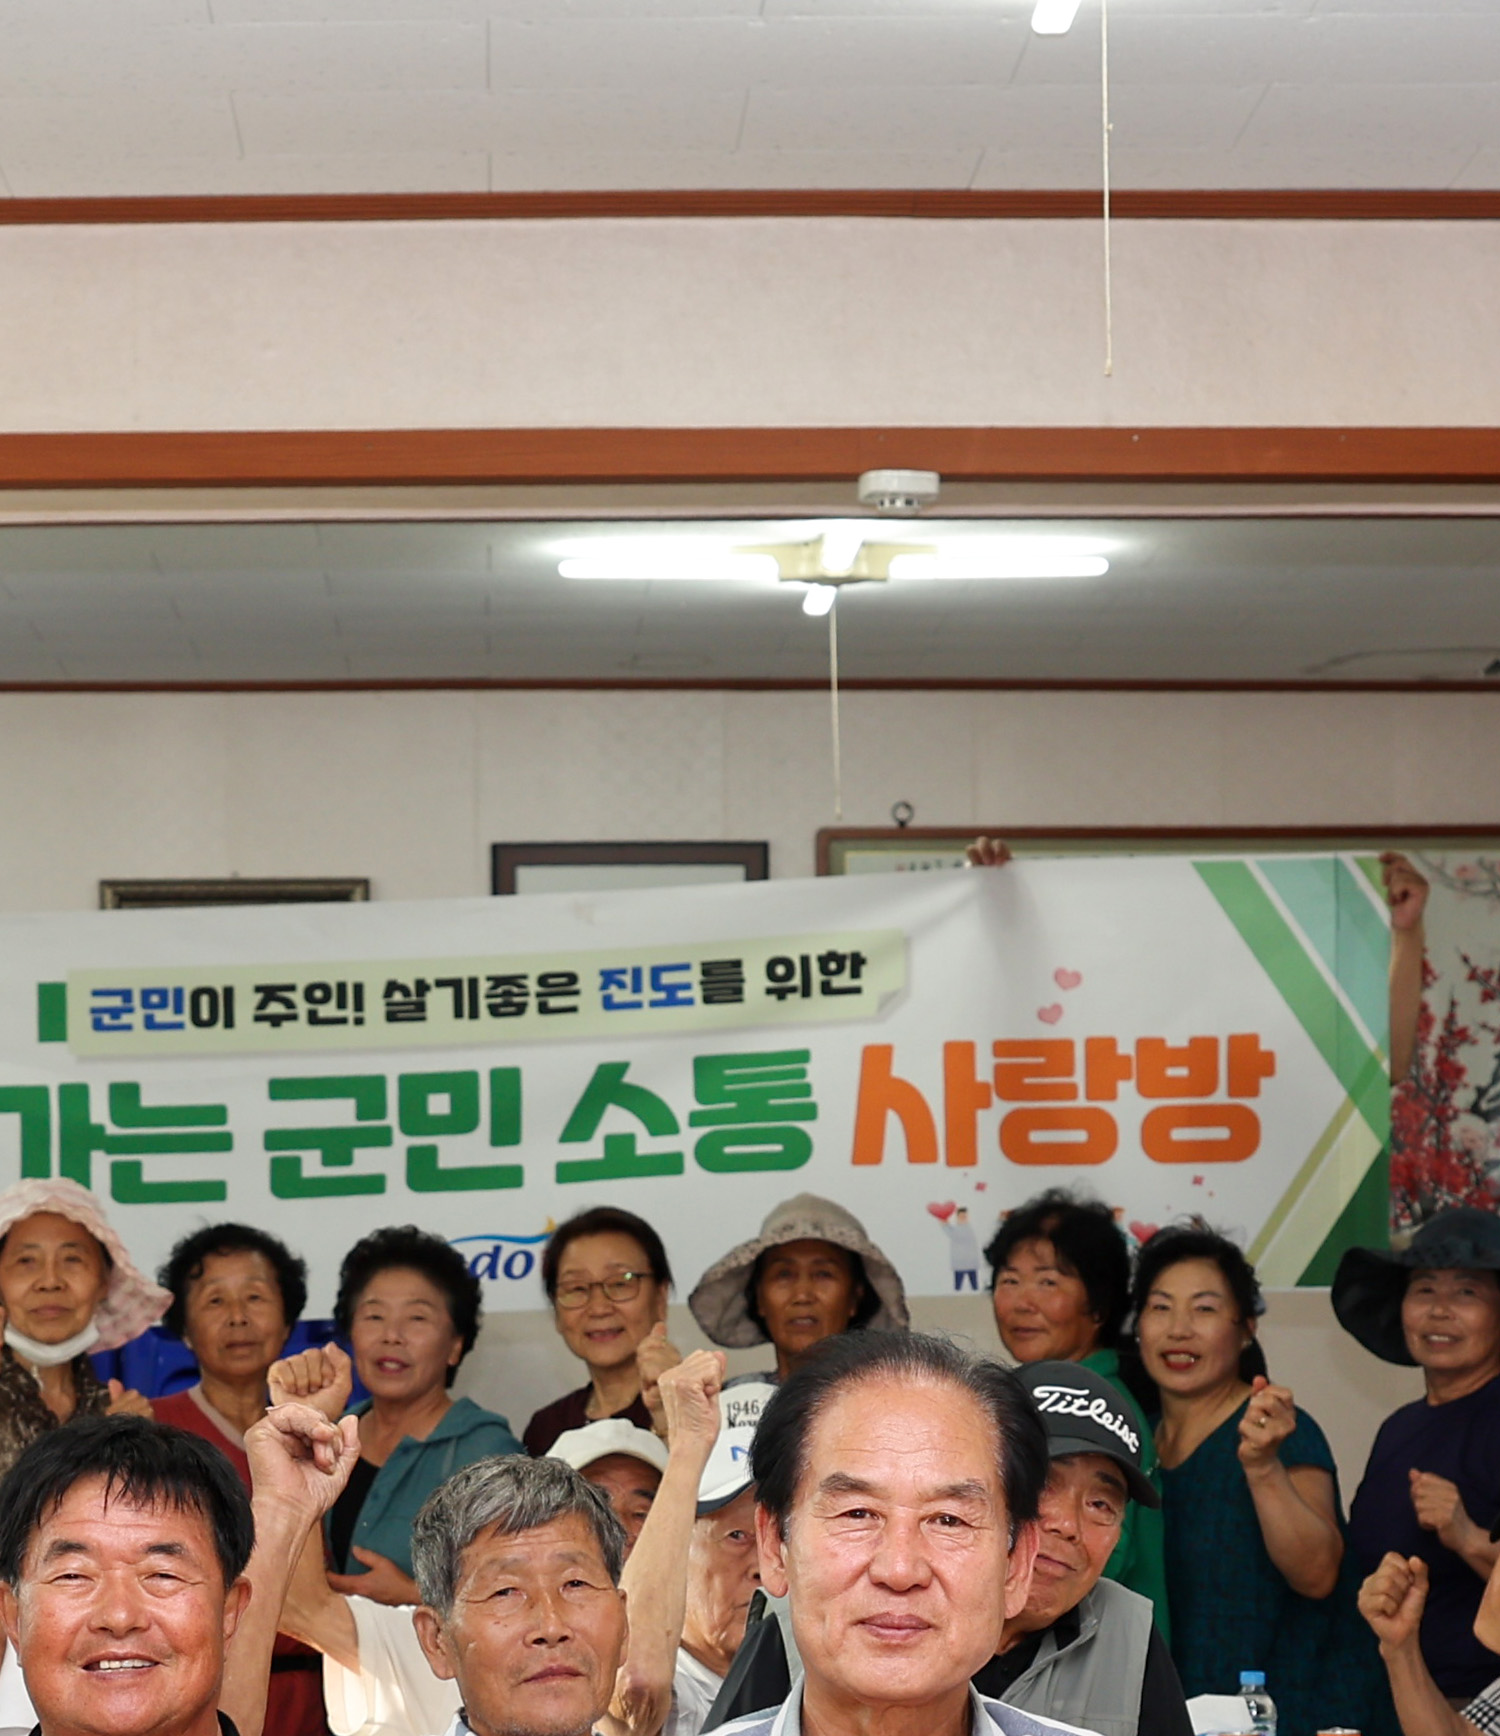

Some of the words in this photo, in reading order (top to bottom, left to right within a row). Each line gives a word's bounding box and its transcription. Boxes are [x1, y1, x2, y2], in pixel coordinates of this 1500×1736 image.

[89, 984, 236, 1032] 군민이
[251, 980, 366, 1027] 주인!
[382, 970, 581, 1022] 살기좋은
[598, 959, 745, 1012] 진도를
[764, 950, 867, 1000] 위한
[263, 1065, 525, 1200] 군민
[554, 1047, 819, 1185] 소통
[851, 1032, 1276, 1168] 사랑방
[1032, 1385, 1140, 1454] Titleist
